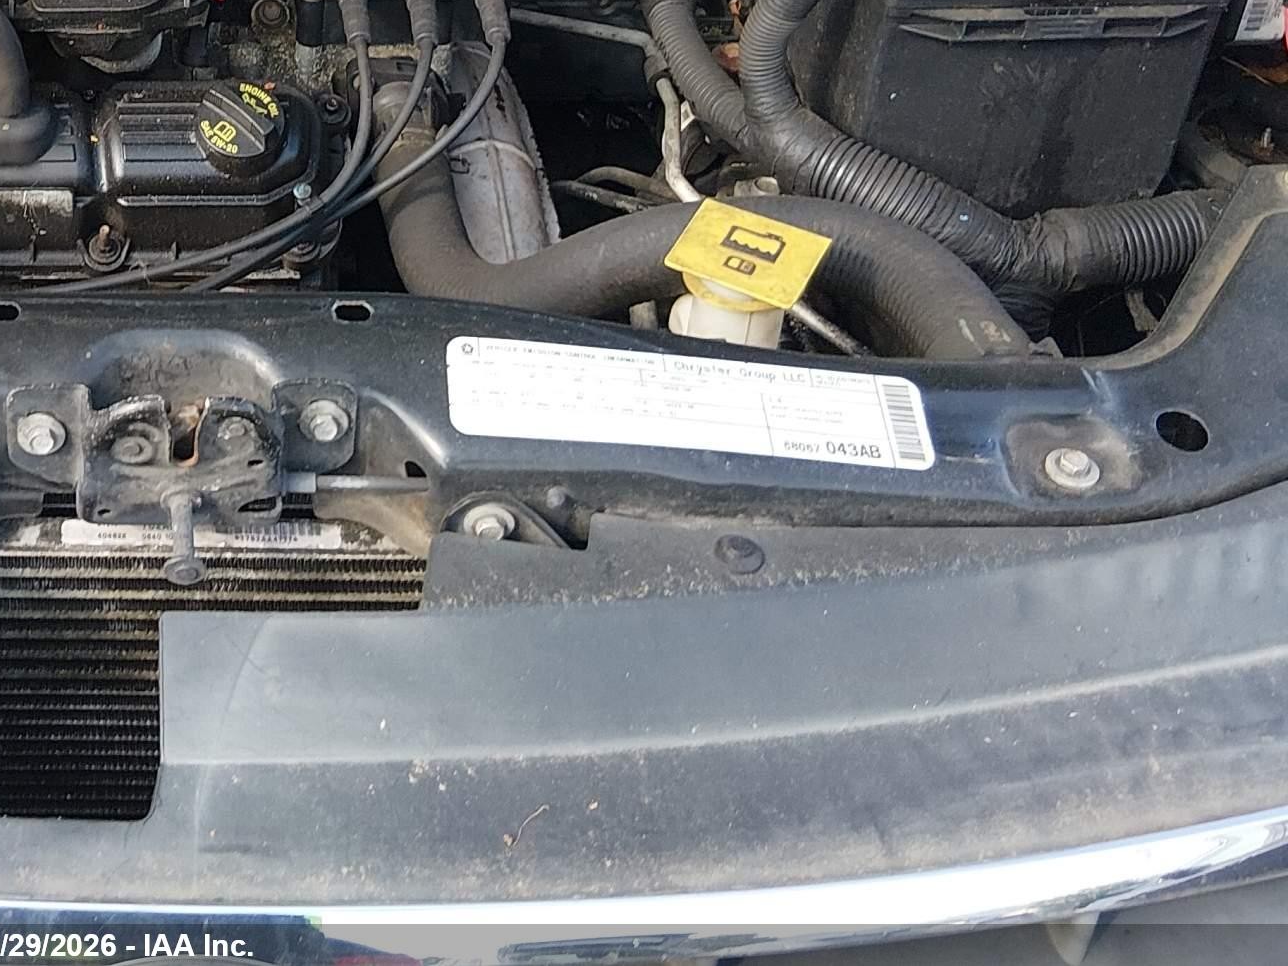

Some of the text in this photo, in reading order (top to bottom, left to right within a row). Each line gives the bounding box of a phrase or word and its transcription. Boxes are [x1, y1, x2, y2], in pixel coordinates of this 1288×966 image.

[239, 83, 280, 118] ENGINE OIL
[200, 120, 214, 138] SAE
[673, 360, 731, 376] Chrysler
[739, 368, 776, 383] Group
[782, 372, 807, 383] LLC
[825, 441, 882, 459] 043AB
